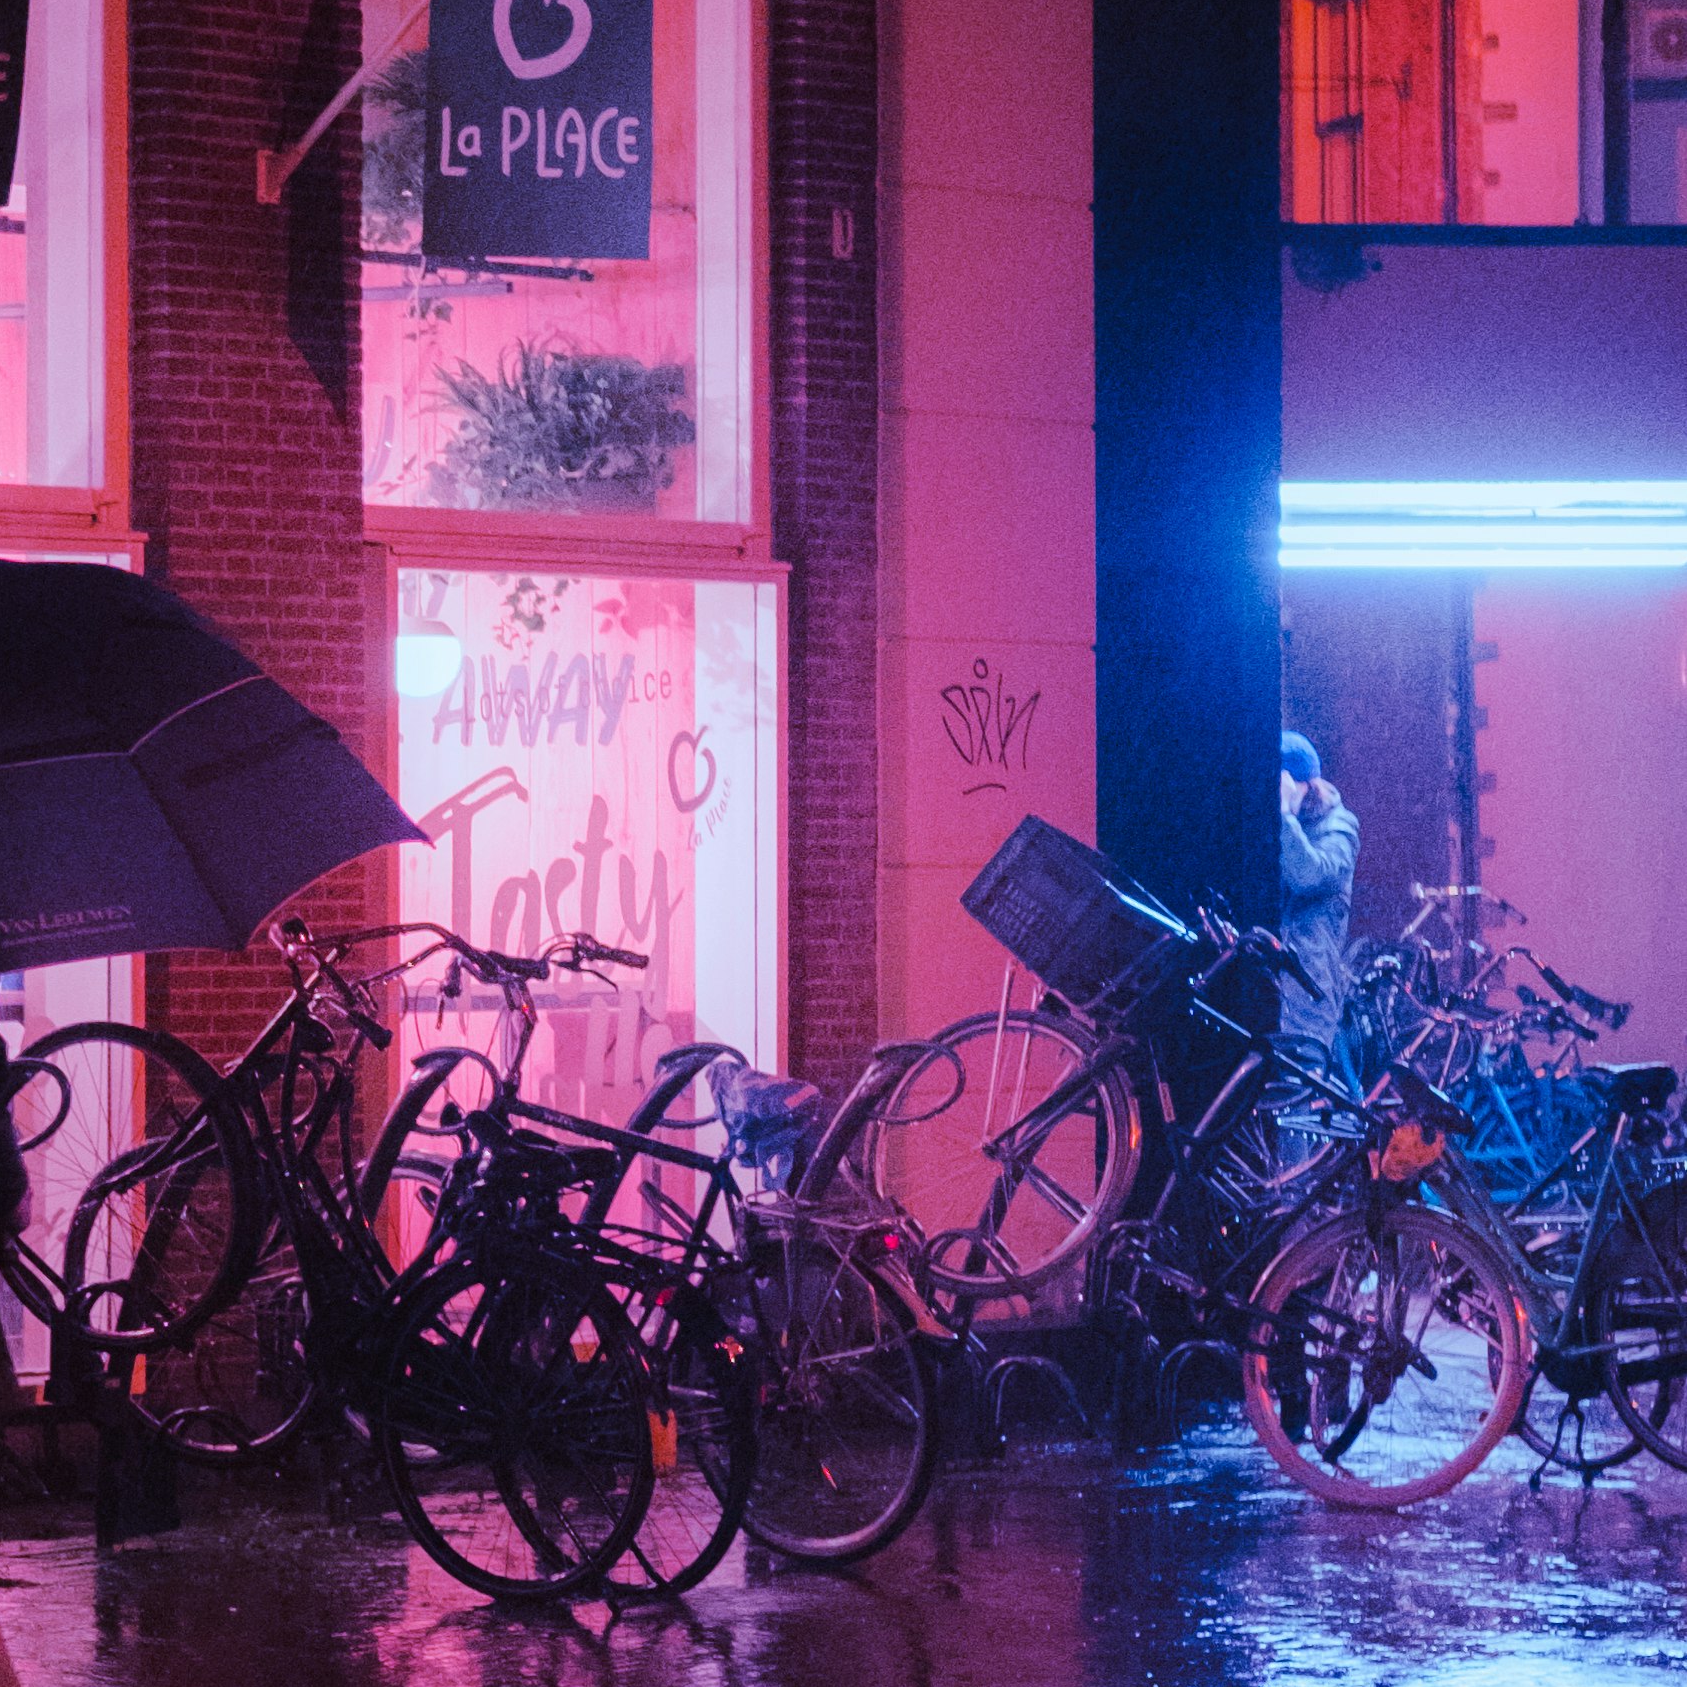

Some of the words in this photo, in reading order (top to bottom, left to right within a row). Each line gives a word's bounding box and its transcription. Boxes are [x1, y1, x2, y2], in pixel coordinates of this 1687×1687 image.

[440, 108, 482, 177] La
[500, 107, 640, 180] PLACE
[433, 651, 635, 747] AWAY
[418, 766, 684, 1022] Tasty
